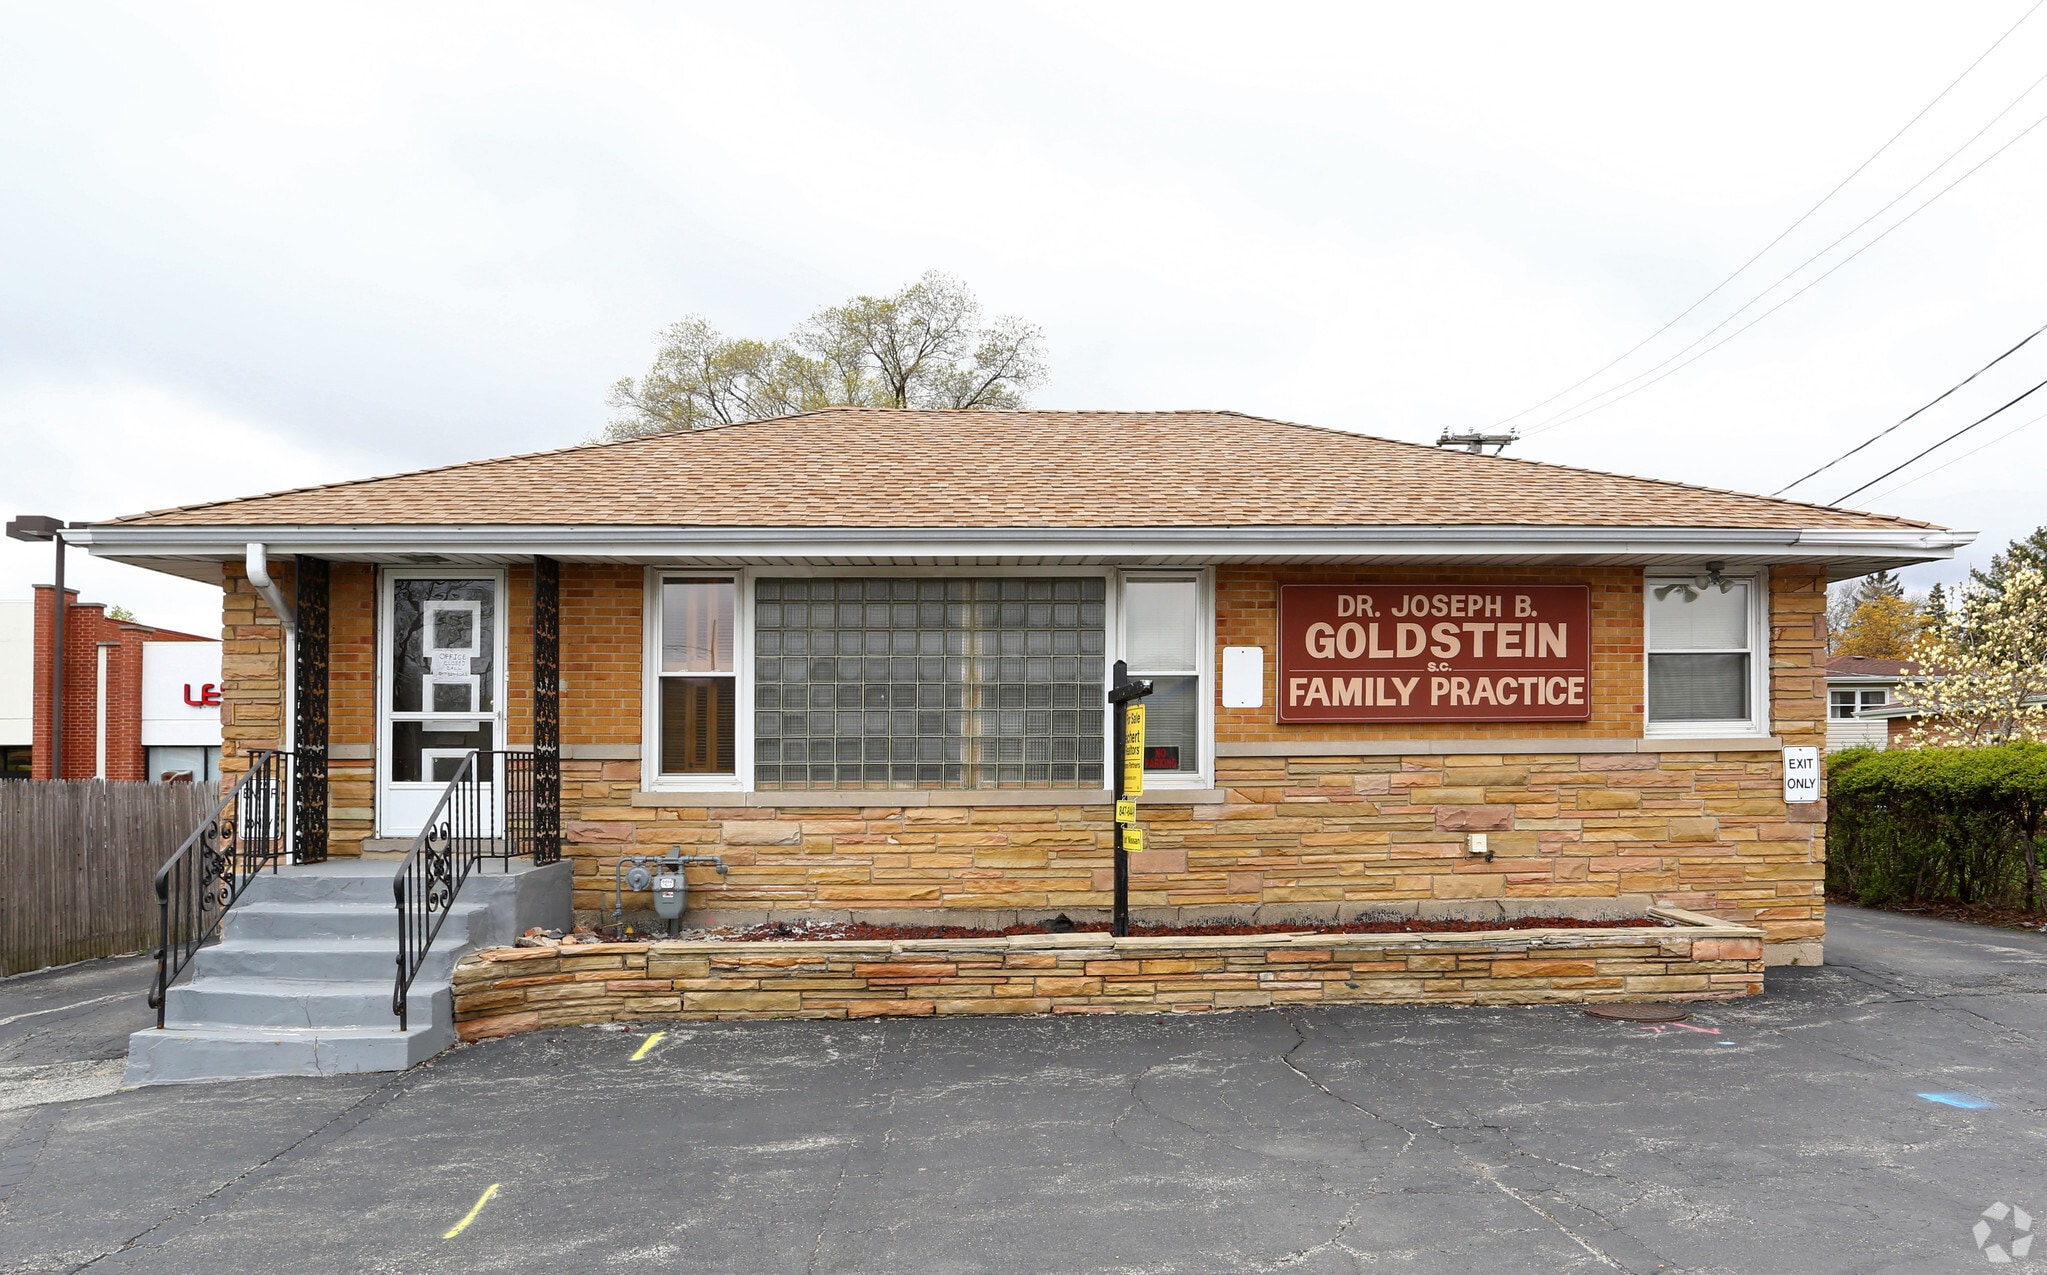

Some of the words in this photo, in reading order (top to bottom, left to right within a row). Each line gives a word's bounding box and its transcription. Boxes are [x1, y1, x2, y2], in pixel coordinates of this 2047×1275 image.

[1337, 595, 1381, 617] DR.
[1391, 595, 1502, 617] JOSEPH
[1515, 595, 1538, 617] B.
[1305, 622, 1567, 659] GOLDSTEIN
[184, 683, 226, 706] LE
[1289, 677, 1420, 706] FAMILY
[1430, 677, 1585, 706] PRACTICE
[1155, 748, 1167, 758] NO
[1145, 758, 1177, 769] PARKING
[1789, 758, 1813, 769] EXIT
[1787, 778, 1816, 789] ONLY
